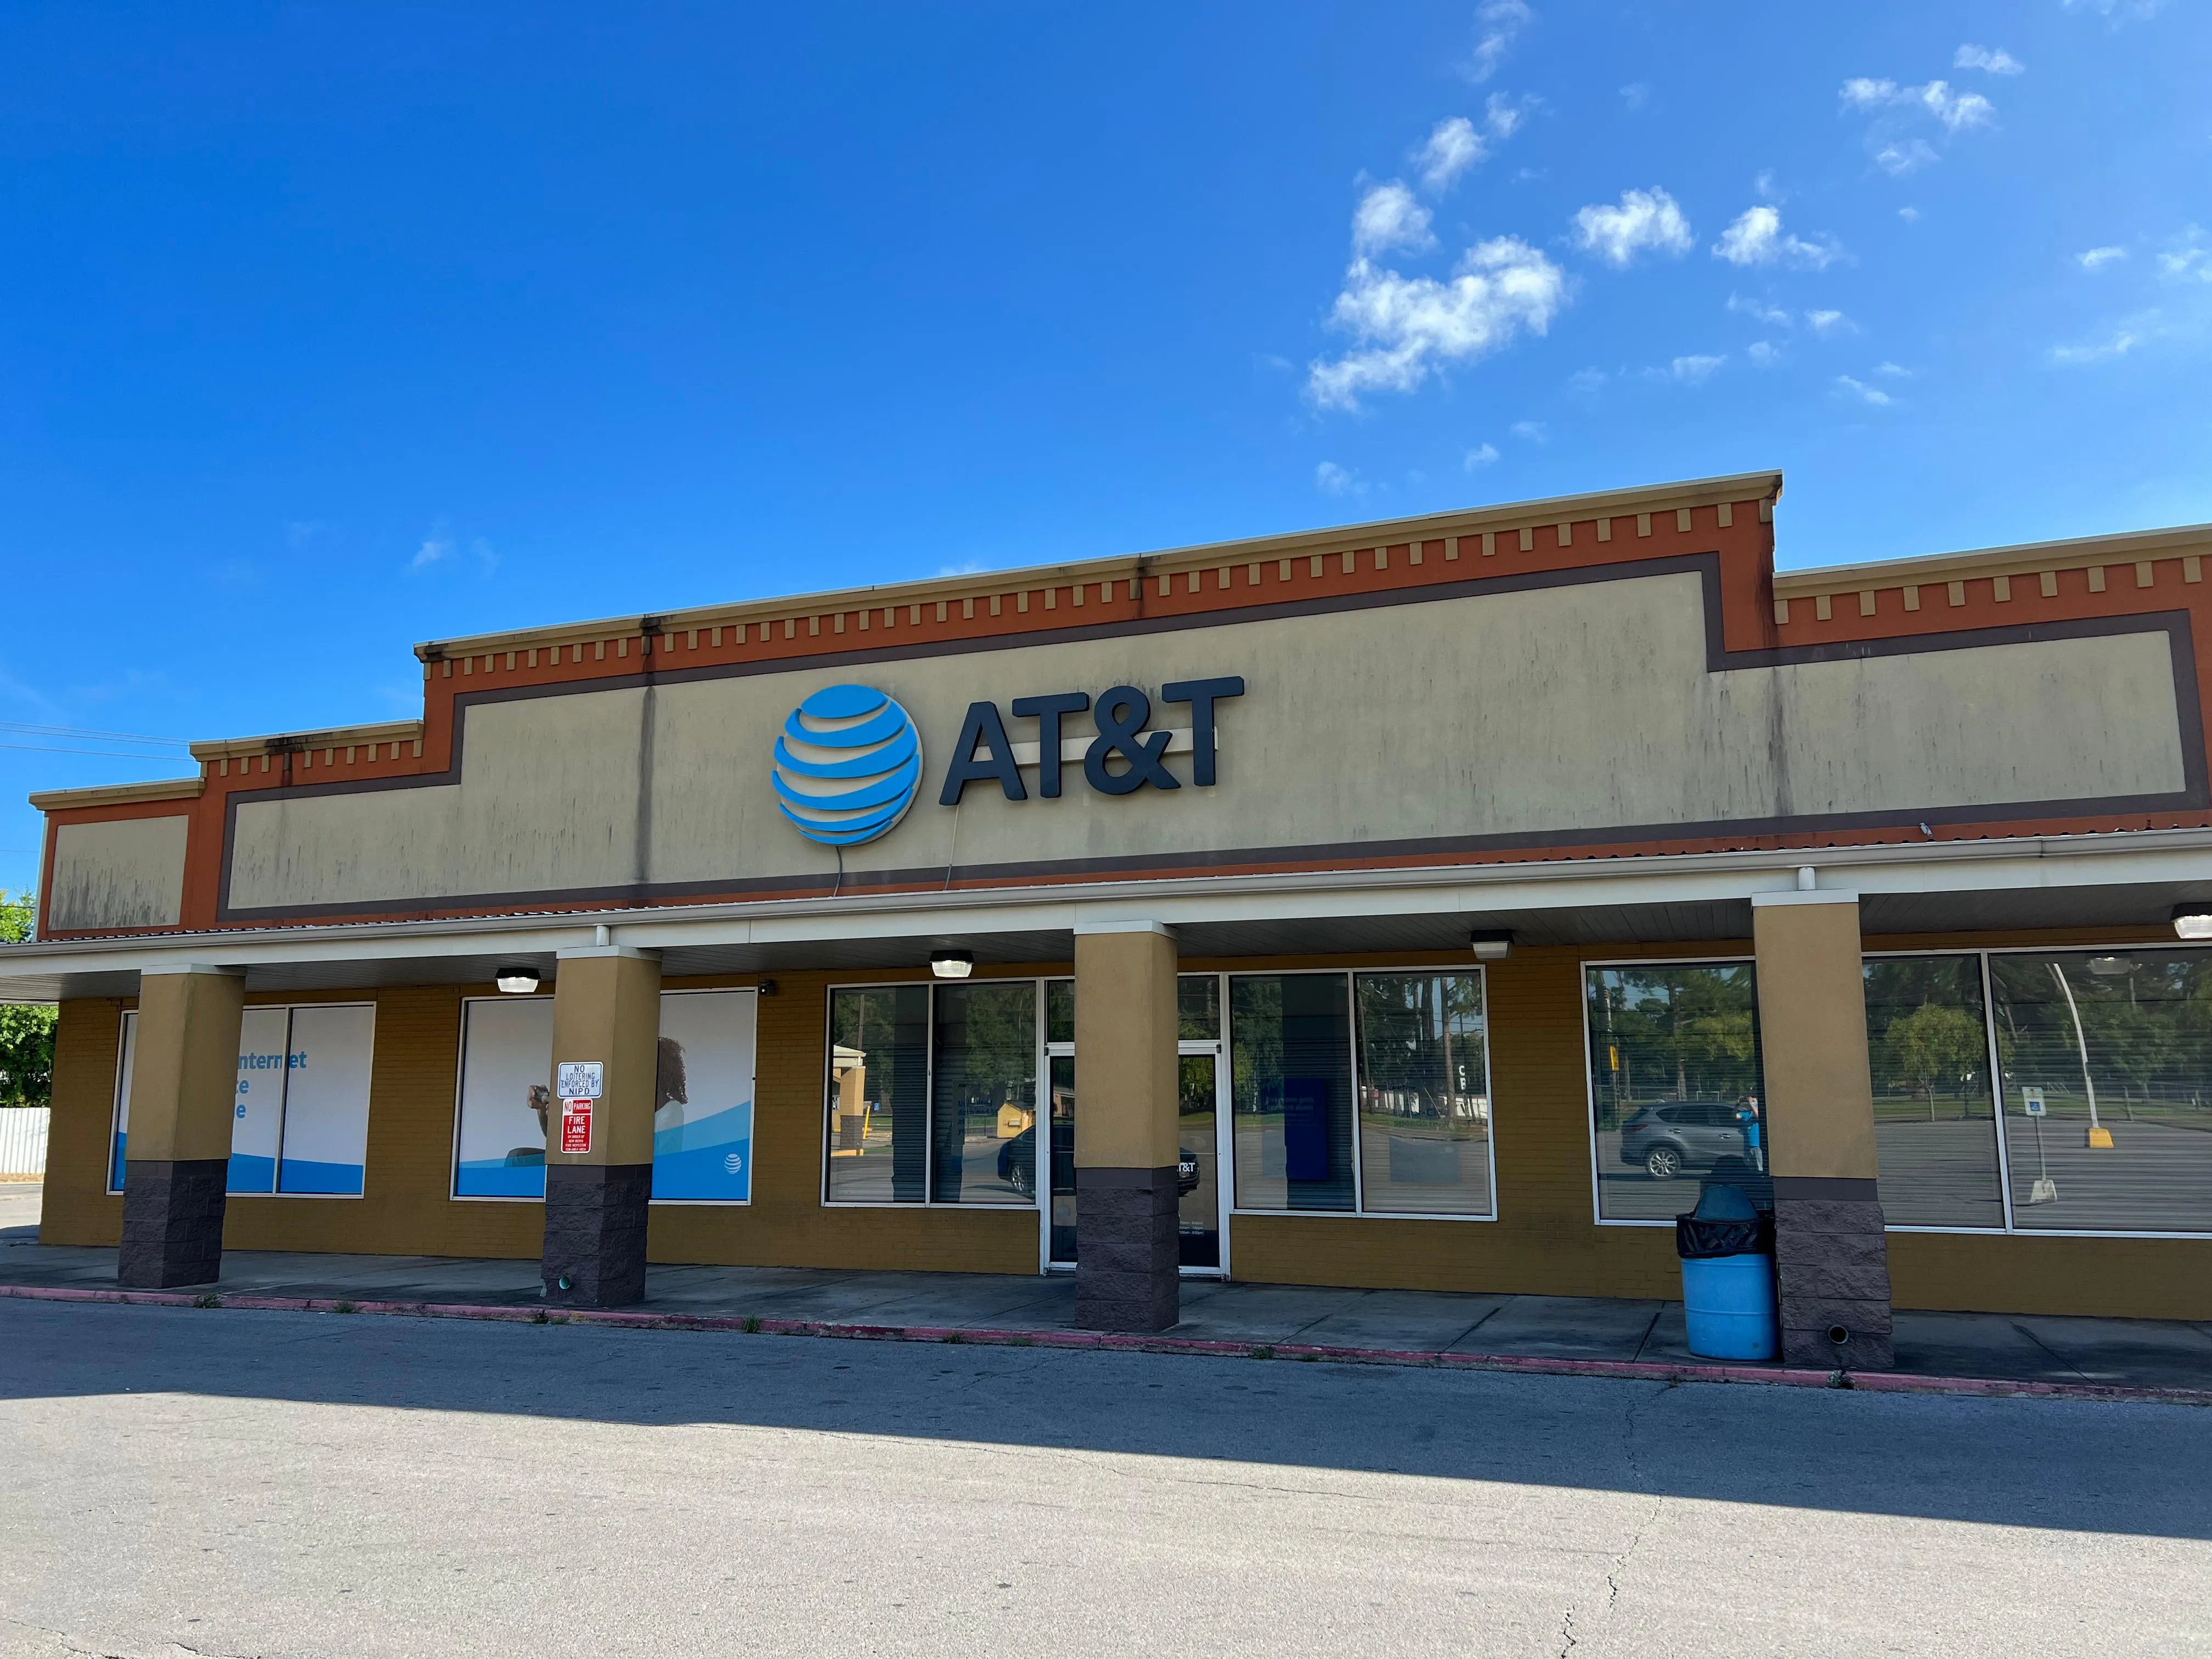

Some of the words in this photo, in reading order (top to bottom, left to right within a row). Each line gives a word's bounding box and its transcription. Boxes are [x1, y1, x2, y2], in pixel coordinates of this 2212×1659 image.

[939, 676, 1244, 806] AT&T
[238, 1051, 307, 1069] nternet
[561, 1080, 589, 1088] ENFORCED
[591, 1079, 599, 1087] BY
[564, 1101, 572, 1111] NO
[568, 1116, 585, 1125] FIRE
[567, 1125, 586, 1134] LANE
[1178, 1162, 1195, 1172] T&T
